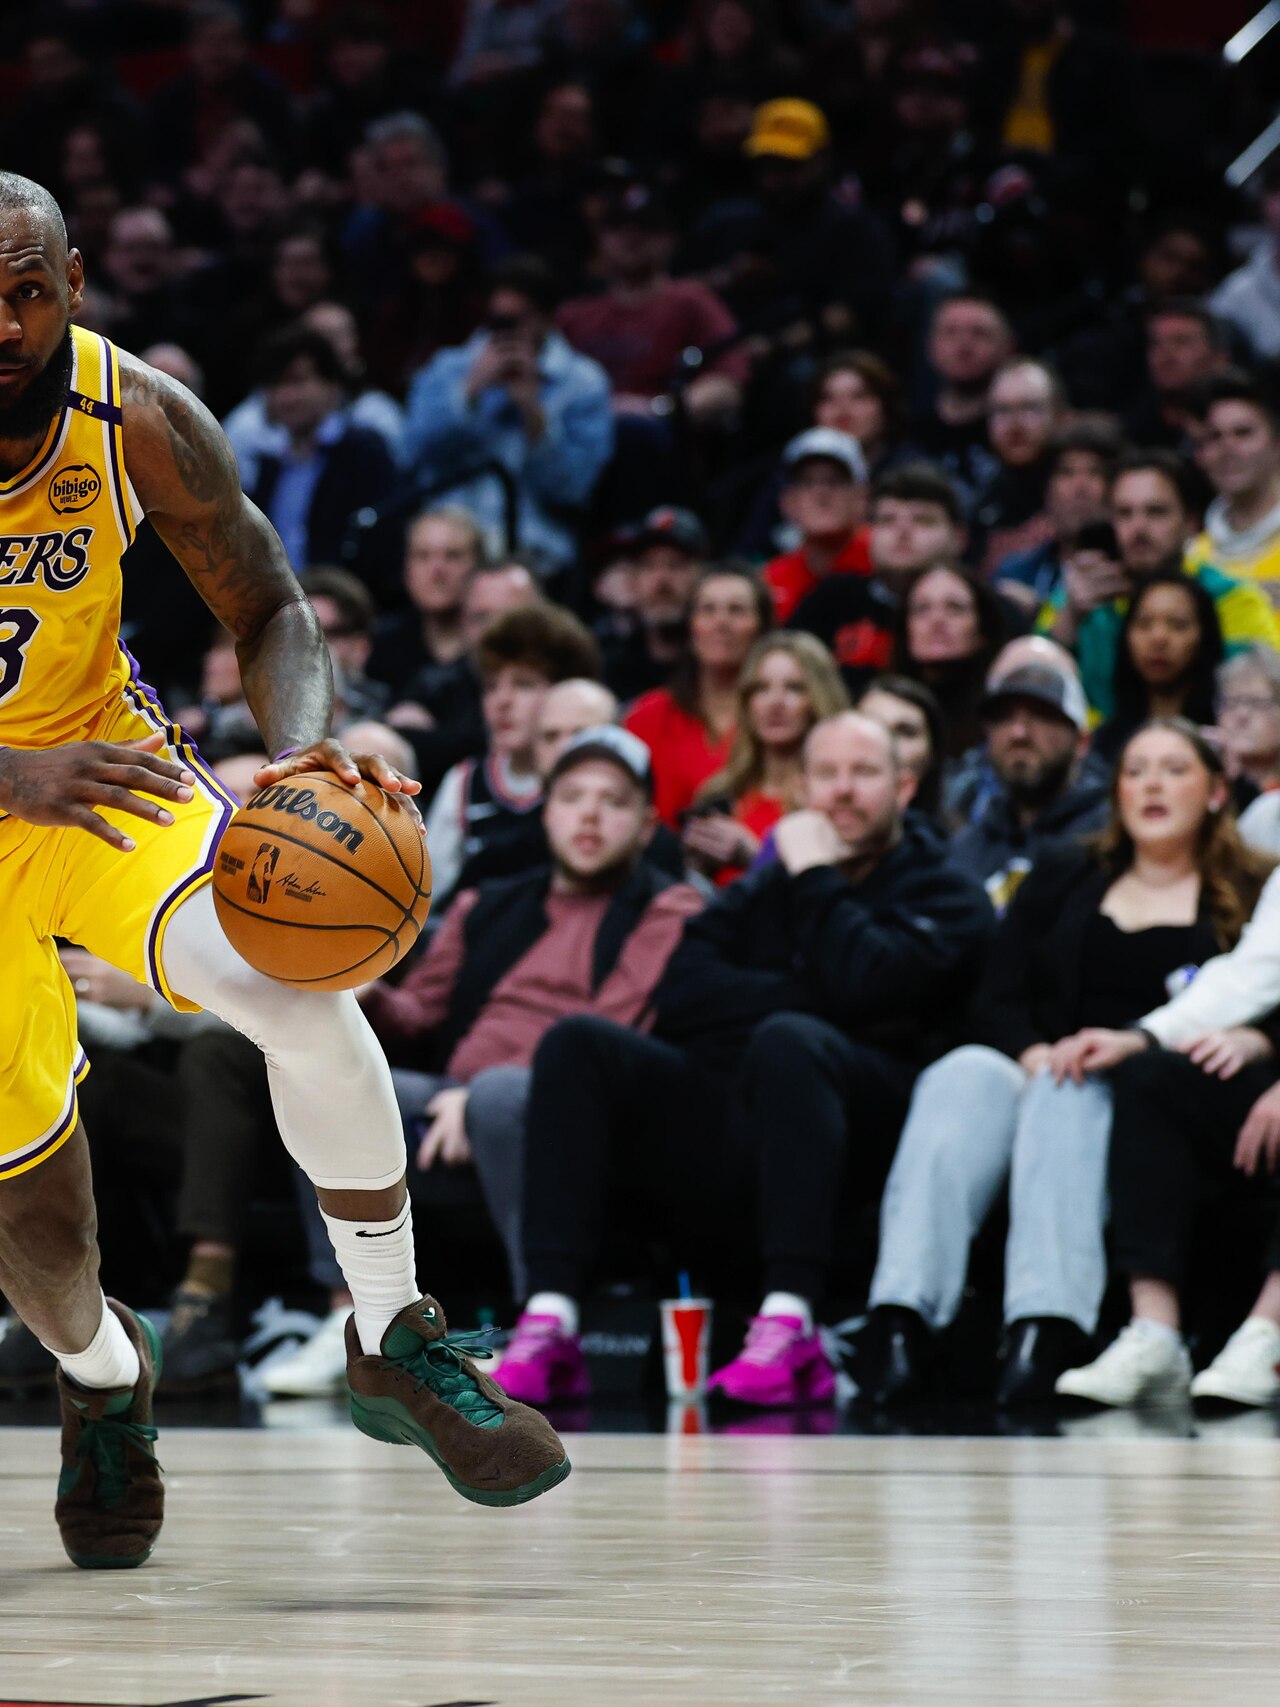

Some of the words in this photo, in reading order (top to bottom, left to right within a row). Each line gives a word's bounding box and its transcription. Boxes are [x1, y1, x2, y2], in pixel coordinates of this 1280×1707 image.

[79, 397, 95, 414] 44
[53, 477, 98, 498] bibigo
[246, 784, 365, 855] Wilson
